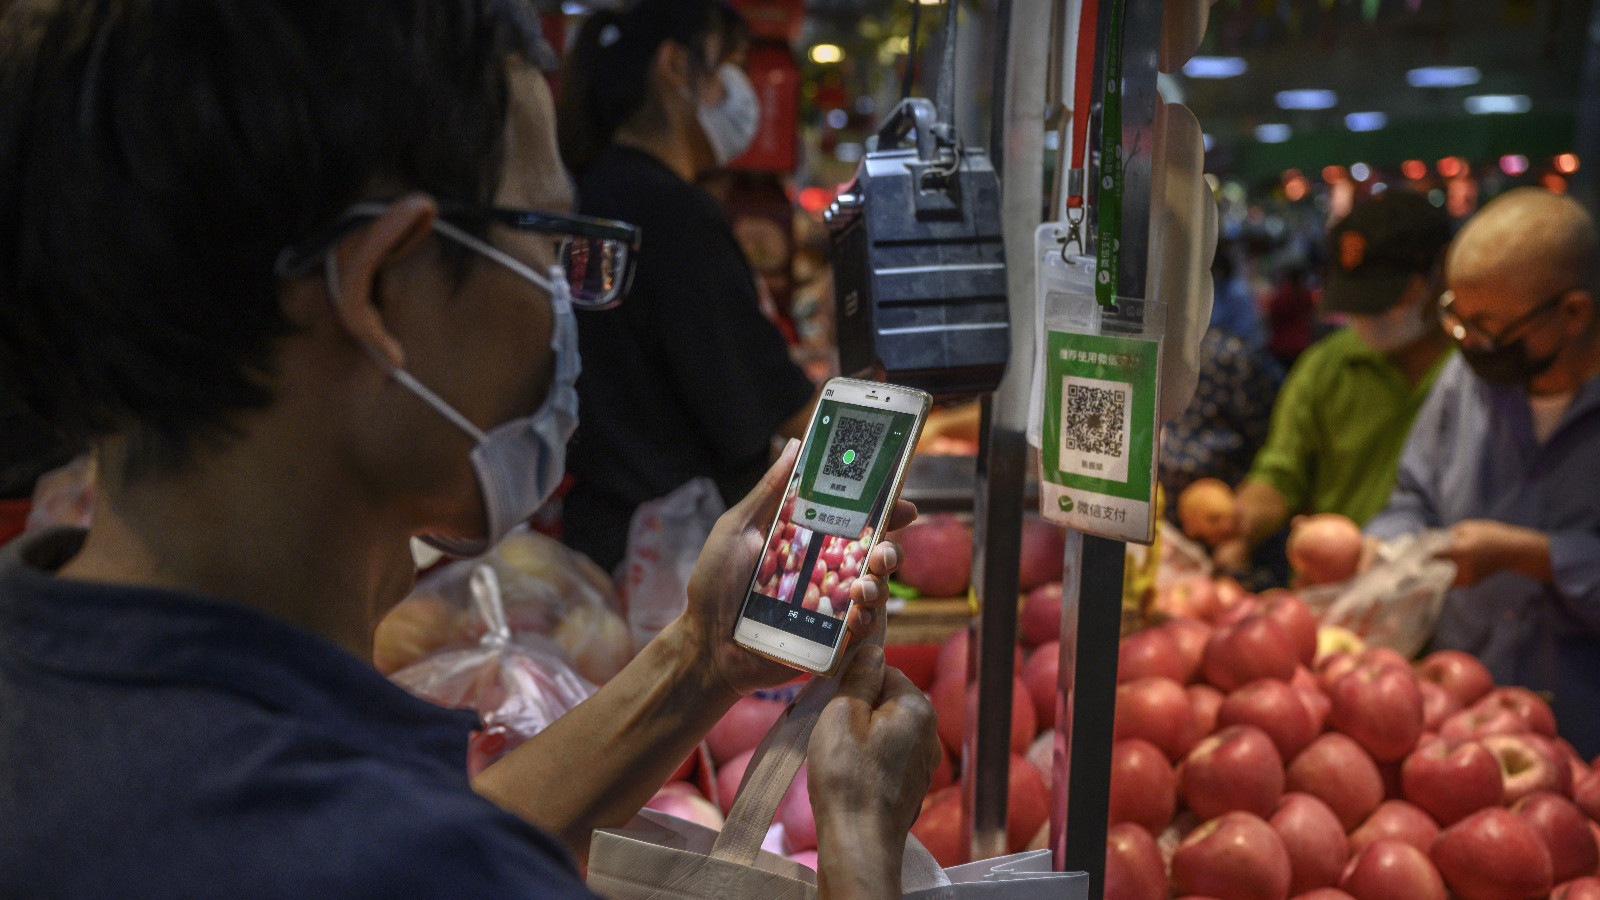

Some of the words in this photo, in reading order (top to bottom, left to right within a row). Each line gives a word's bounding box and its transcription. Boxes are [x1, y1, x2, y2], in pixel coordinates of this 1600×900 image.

[1101, 232, 1110, 267] 微信支付
[1060, 349, 1139, 367] 推荐使用微信
[818, 513, 851, 527] 微信支付
[1077, 501, 1126, 522] 微信支付
